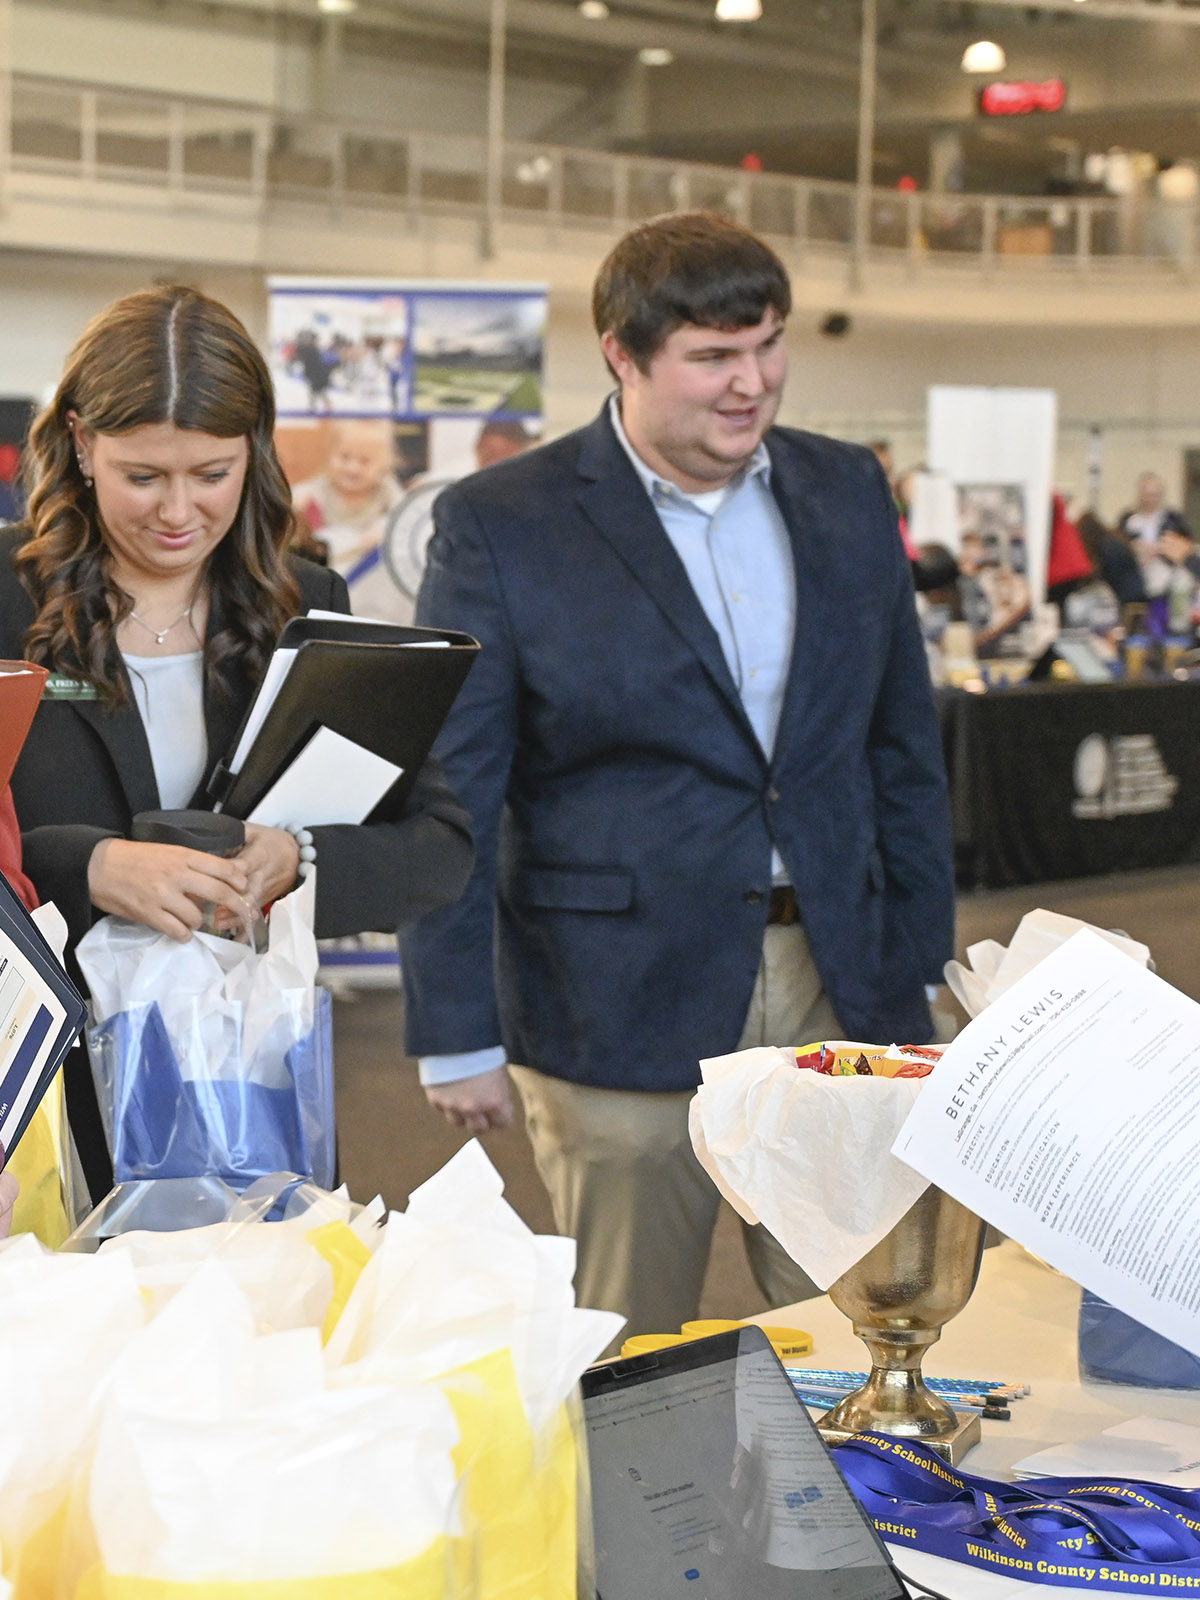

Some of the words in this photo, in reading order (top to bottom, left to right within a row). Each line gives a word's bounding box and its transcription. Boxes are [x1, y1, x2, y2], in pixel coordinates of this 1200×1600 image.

[943, 1032, 1011, 1120] BETHANY
[1009, 986, 1063, 1034] LEWIS
[959, 1122, 986, 1167] OBJECTIVE
[983, 1137, 1011, 1184] EDUCATION
[1010, 1180, 1026, 1204] GACE
[1022, 1119, 1061, 1181] CERTIFICATION
[1038, 1198, 1054, 1223] WORK
[1050, 1149, 1082, 1199] EXPERIENCE
[891, 1444, 932, 1471] School
[931, 1461, 965, 1490] District
[1067, 1485, 1121, 1495] District
[1120, 1488, 1171, 1515] hool
[872, 1518, 918, 1540] istrict
[966, 1542, 1034, 1571] Wilkinson
[1036, 1560, 1096, 1581] County
[1099, 1567, 1156, 1585] School
